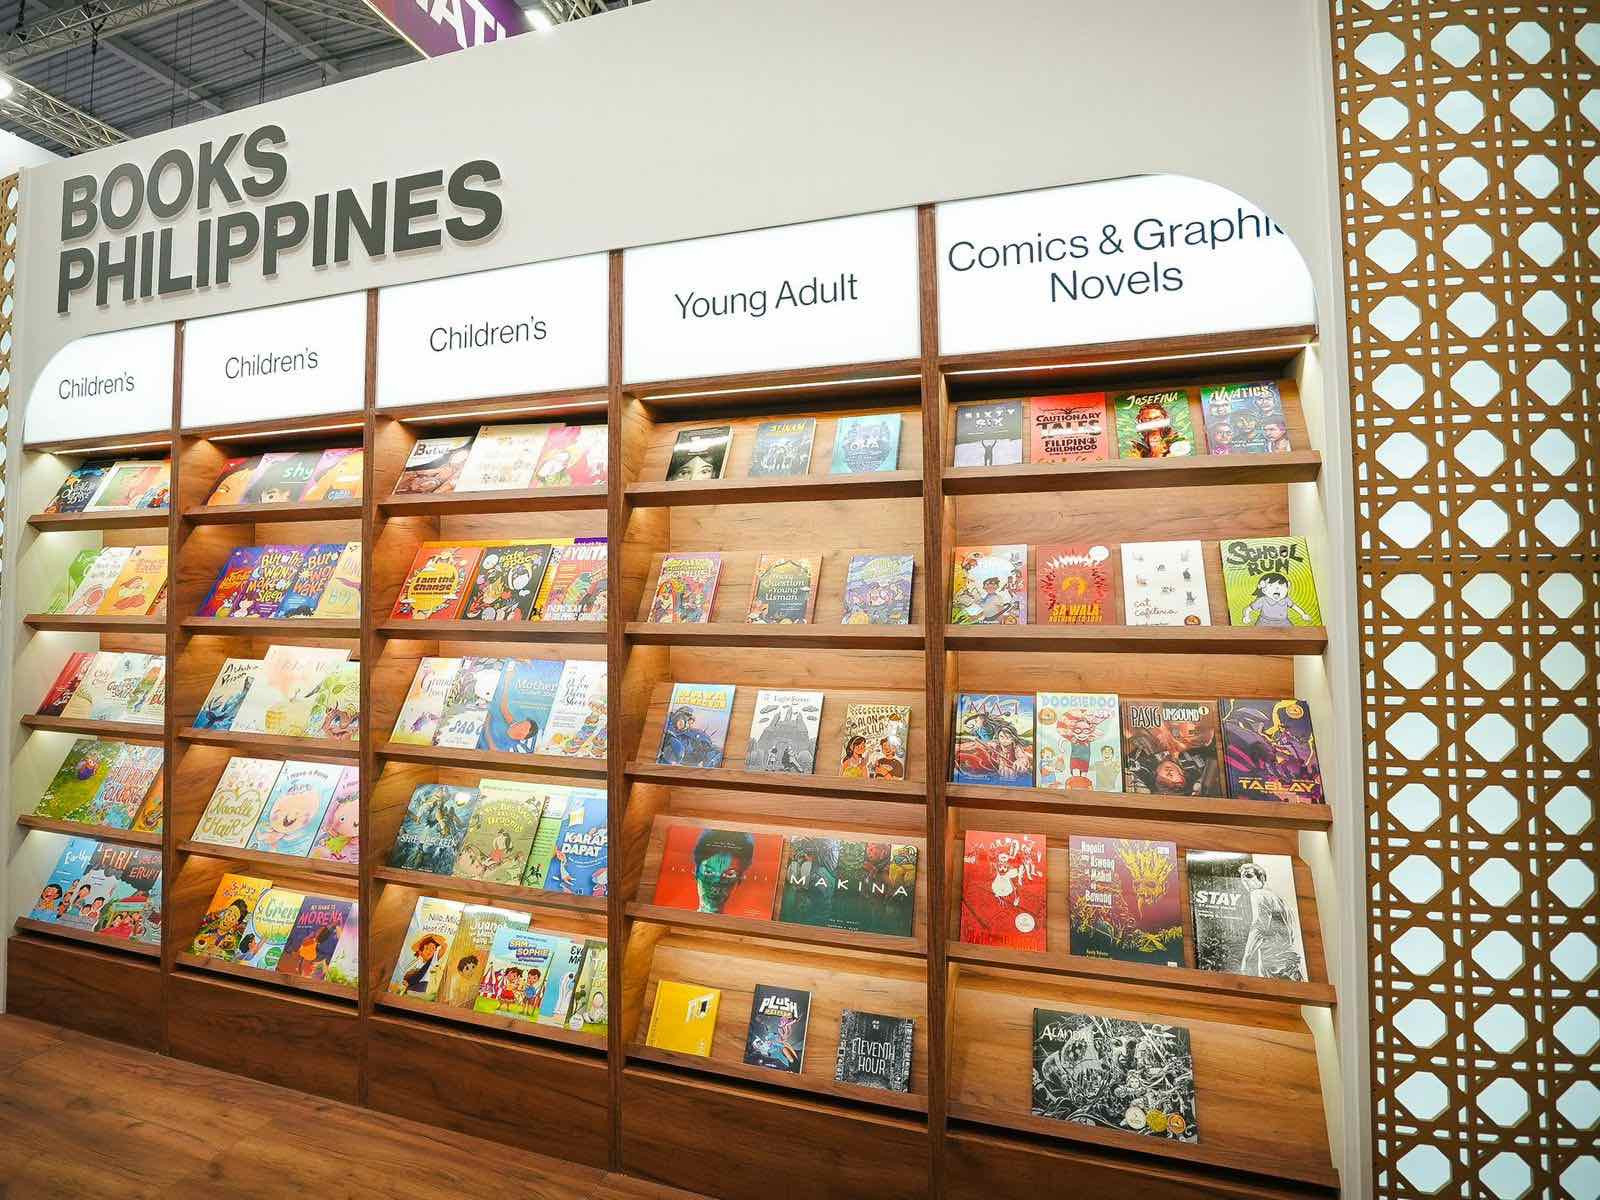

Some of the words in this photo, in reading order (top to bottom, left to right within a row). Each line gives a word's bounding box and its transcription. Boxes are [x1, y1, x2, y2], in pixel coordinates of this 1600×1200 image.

[60, 124, 289, 243] BOOKS
[56, 159, 504, 314] PHILIPPINES
[949, 232, 1089, 272] Comics
[1099, 224, 1124, 255] &
[1050, 261, 1184, 302] Novels
[674, 289, 768, 319] Young
[775, 273, 859, 309] Adult
[429, 316, 548, 353] Children's
[224, 347, 320, 380] Children's
[58, 371, 136, 400] Children's
[1121, 391, 1178, 410] JOSEFINA
[1036, 411, 1102, 423] CAUTIONARY
[1044, 437, 1098, 448] FILIPINO
[1044, 444, 1098, 453] CHILDHOOD
[282, 461, 314, 480] shy
[1226, 541, 1303, 565] SCHOOL
[437, 575, 455, 584] the
[1131, 705, 1162, 728] PASIG
[1162, 707, 1201, 722] UNBOUND
[1238, 779, 1316, 793] TABLAY
[561, 842, 601, 856] DAPAT
[790, 874, 908, 898] MAKINA
[1195, 890, 1241, 906] STAY
[298, 911, 344, 926] MORENA
[508, 939, 528, 950] SAM
[516, 948, 549, 957] SOPHIE
[759, 995, 798, 1018] PLUSH
[851, 1037, 895, 1060] ELEVENTH
[858, 1053, 886, 1075] HOUR
